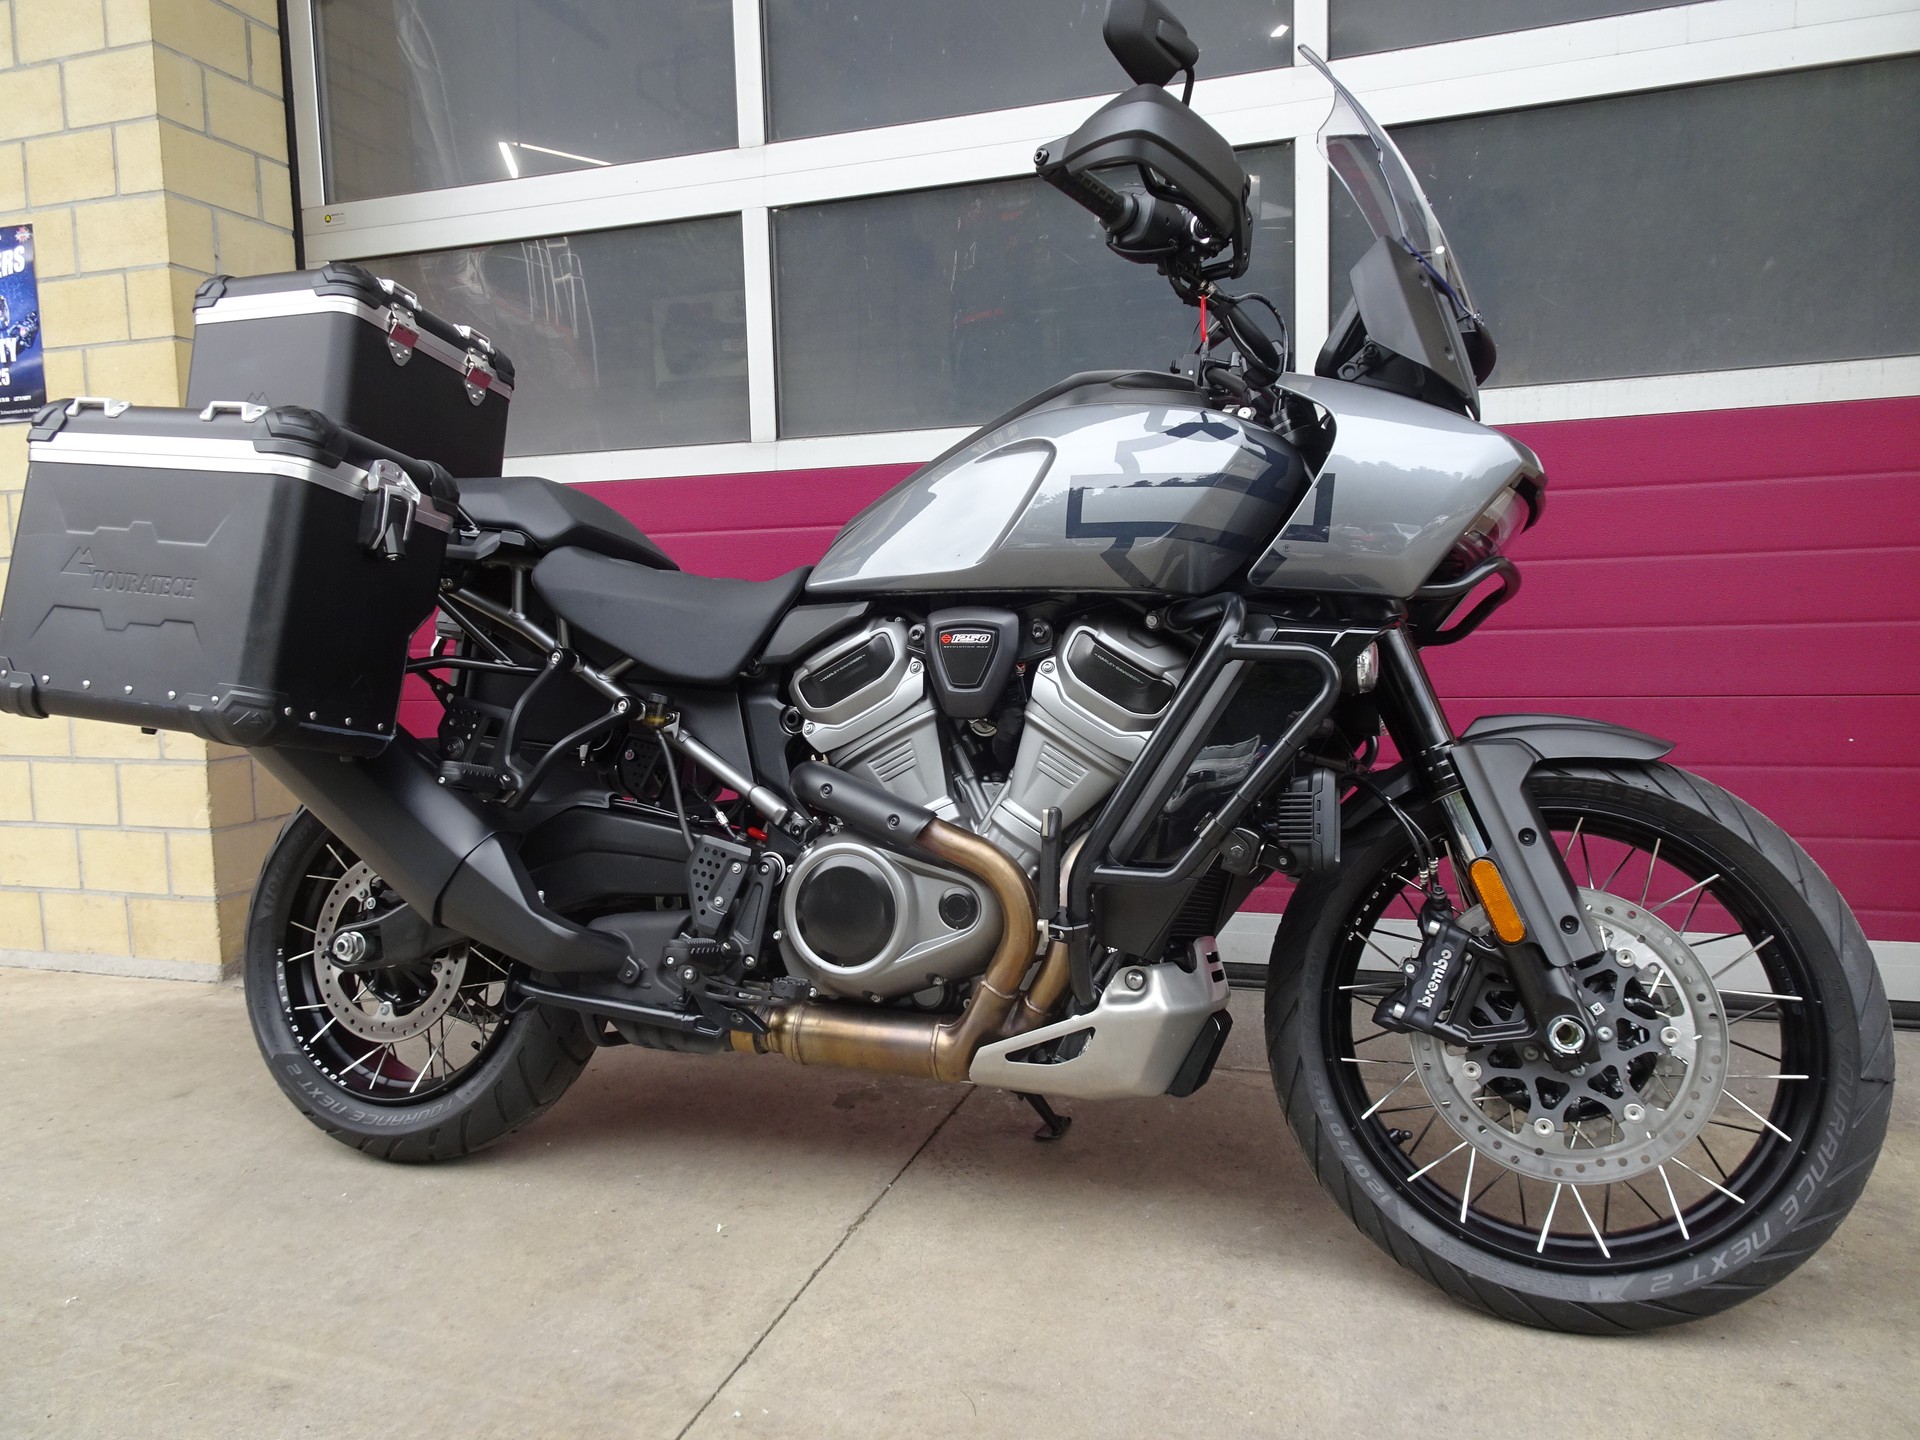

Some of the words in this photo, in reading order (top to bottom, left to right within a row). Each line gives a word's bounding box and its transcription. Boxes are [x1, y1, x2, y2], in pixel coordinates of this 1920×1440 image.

[0, 245, 25, 278] RS
[92, 569, 198, 599] TOURATECH
[1417, 949, 1453, 1008] brembo
[1650, 1273, 1675, 1294] 2
